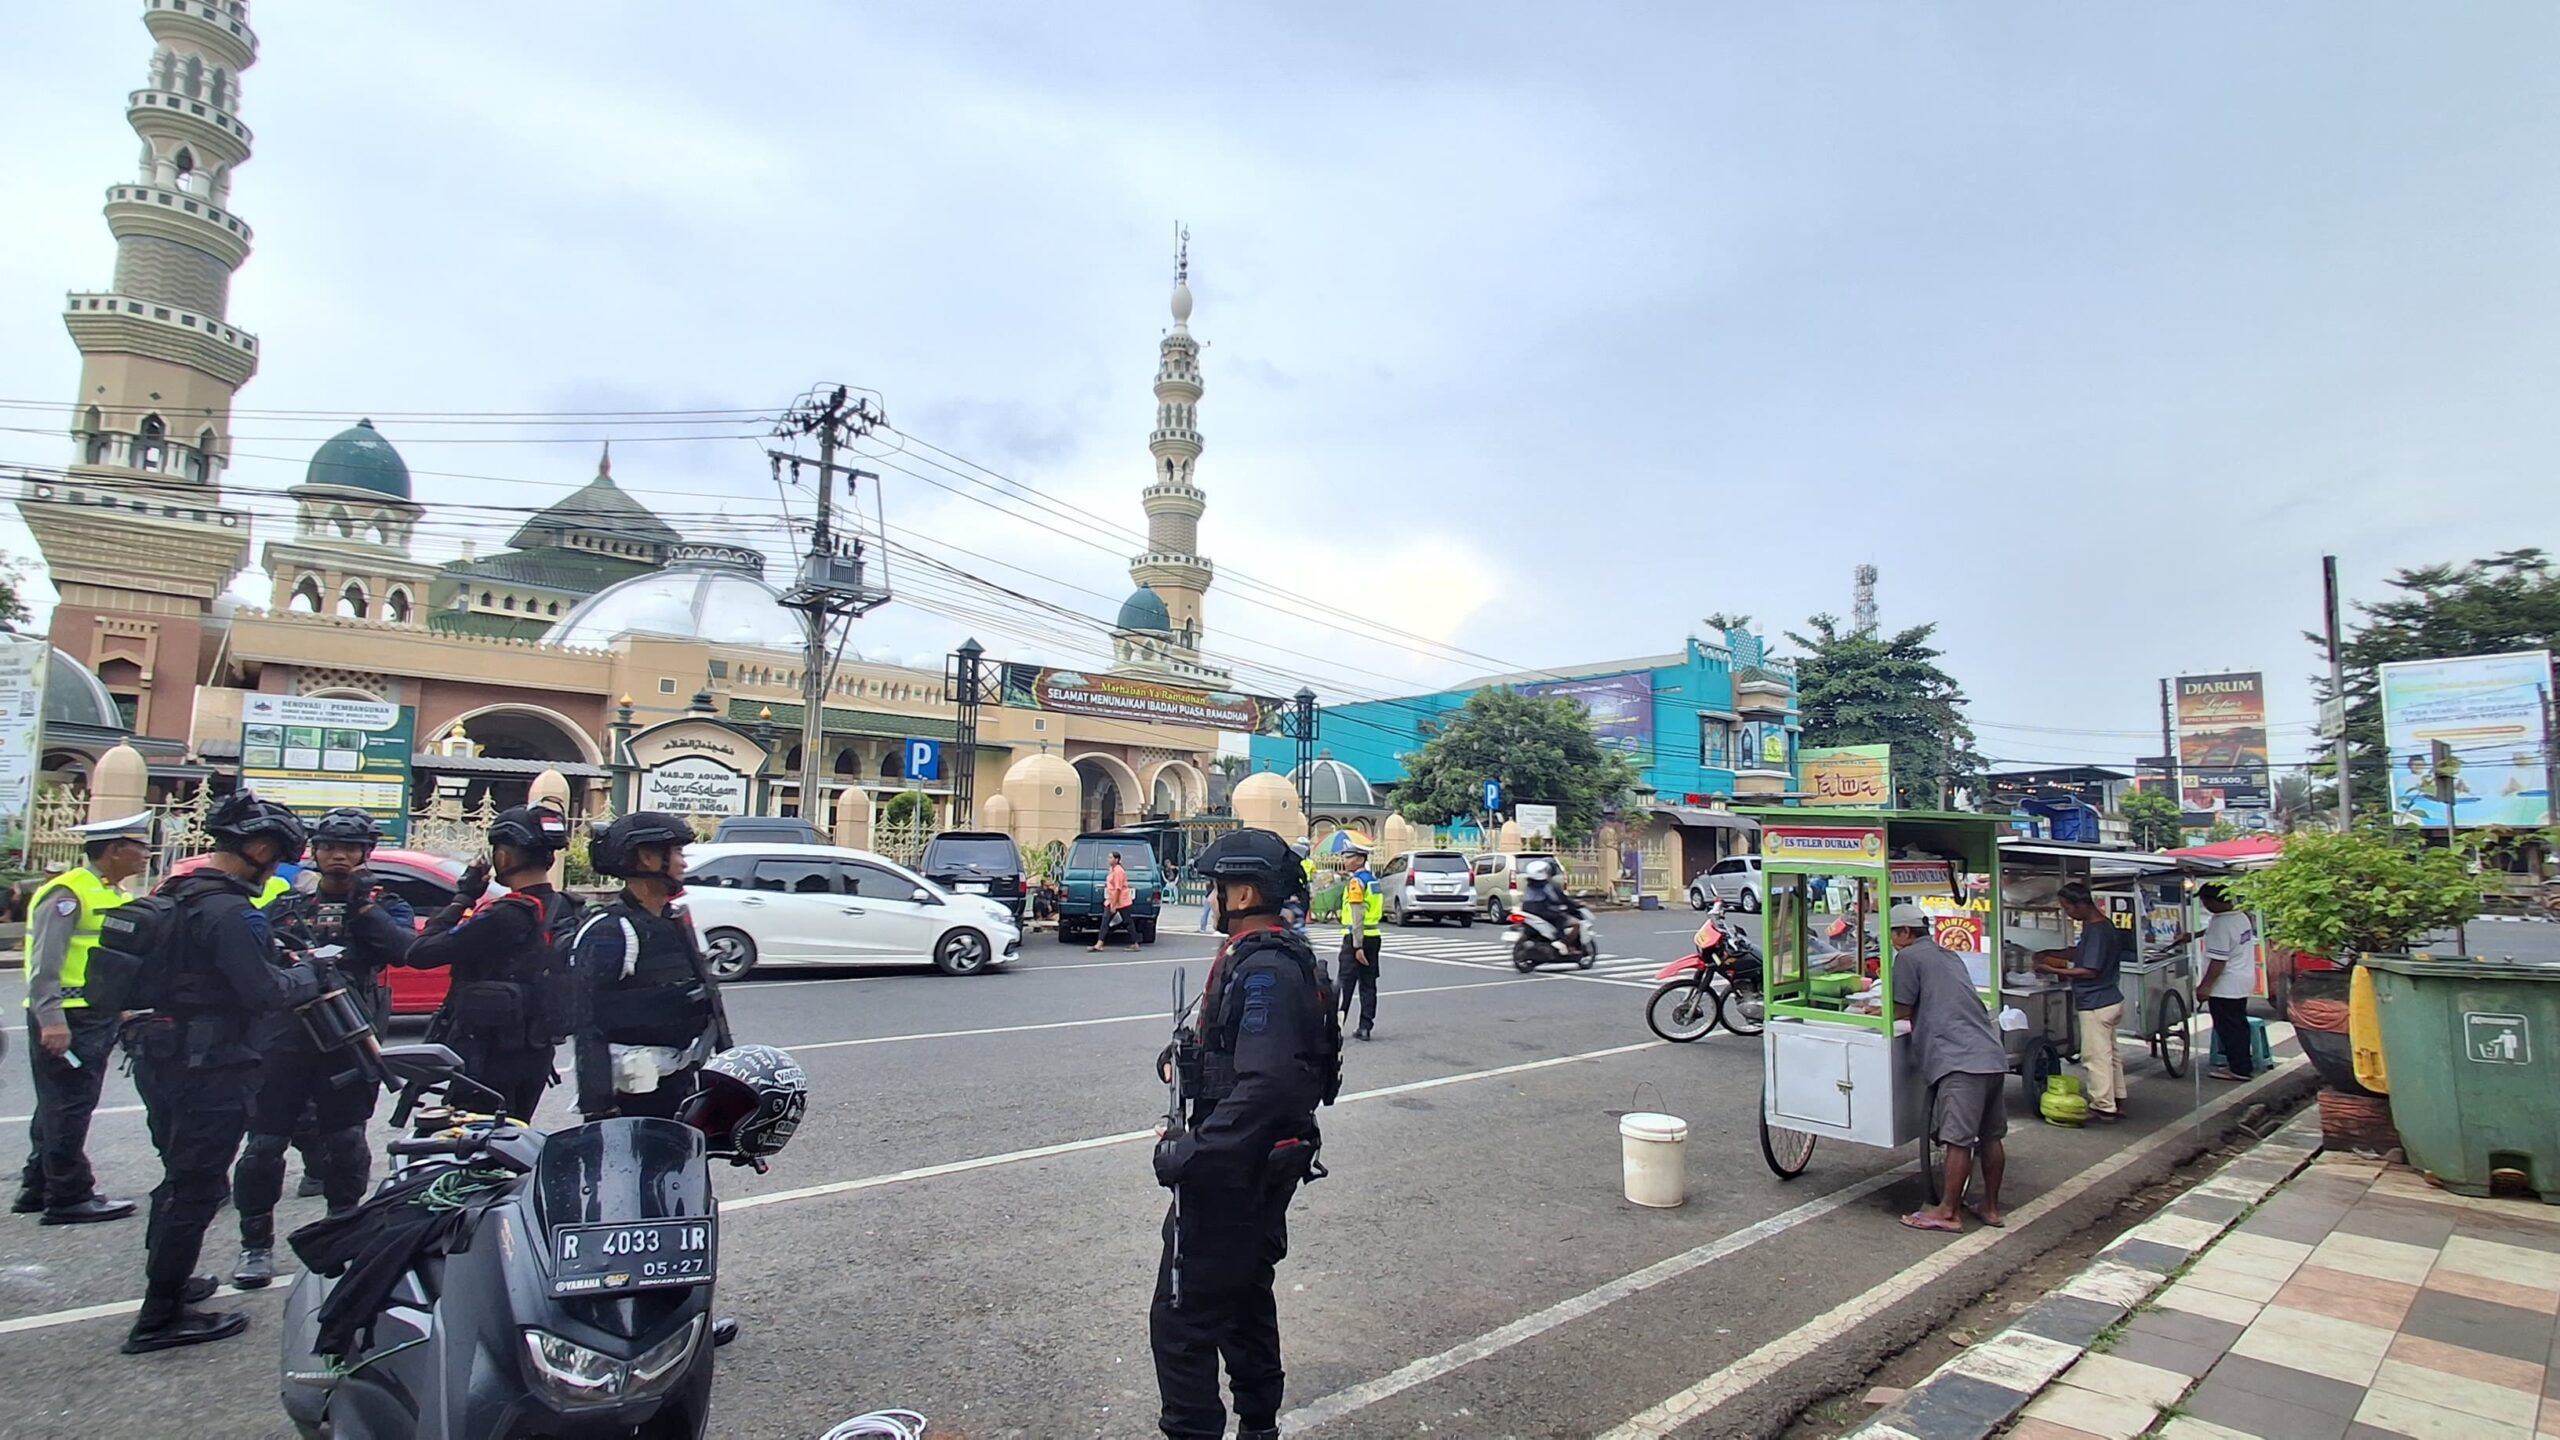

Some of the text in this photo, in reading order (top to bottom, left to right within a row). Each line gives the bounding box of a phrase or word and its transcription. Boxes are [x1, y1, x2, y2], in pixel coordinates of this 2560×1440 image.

[1101, 682, 1205, 704] Marhaban Ya Ramadhan
[2185, 680, 2254, 695] DJARUM
[331, 704, 390, 714] PEMBANGUNAN
[1047, 688, 1088, 702] SELAMAT
[1090, 693, 1146, 710] MENUNAIKAN
[1147, 700, 1178, 713] IBADAH
[1179, 705, 1205, 717] PUASA
[1206, 709, 1249, 722] RAMADHAN
[912, 743, 931, 775] P
[660, 771, 730, 781] MASJID AGUNG
[1487, 784, 1498, 807] P
[657, 802, 729, 812] PURBAINGGA
[1785, 837, 1859, 849] ES TELER DURIAN
[1936, 918, 1978, 933] WONTON
[563, 1227, 706, 1259] R 4033 IR
[566, 1278, 601, 1290] YAMAHA
